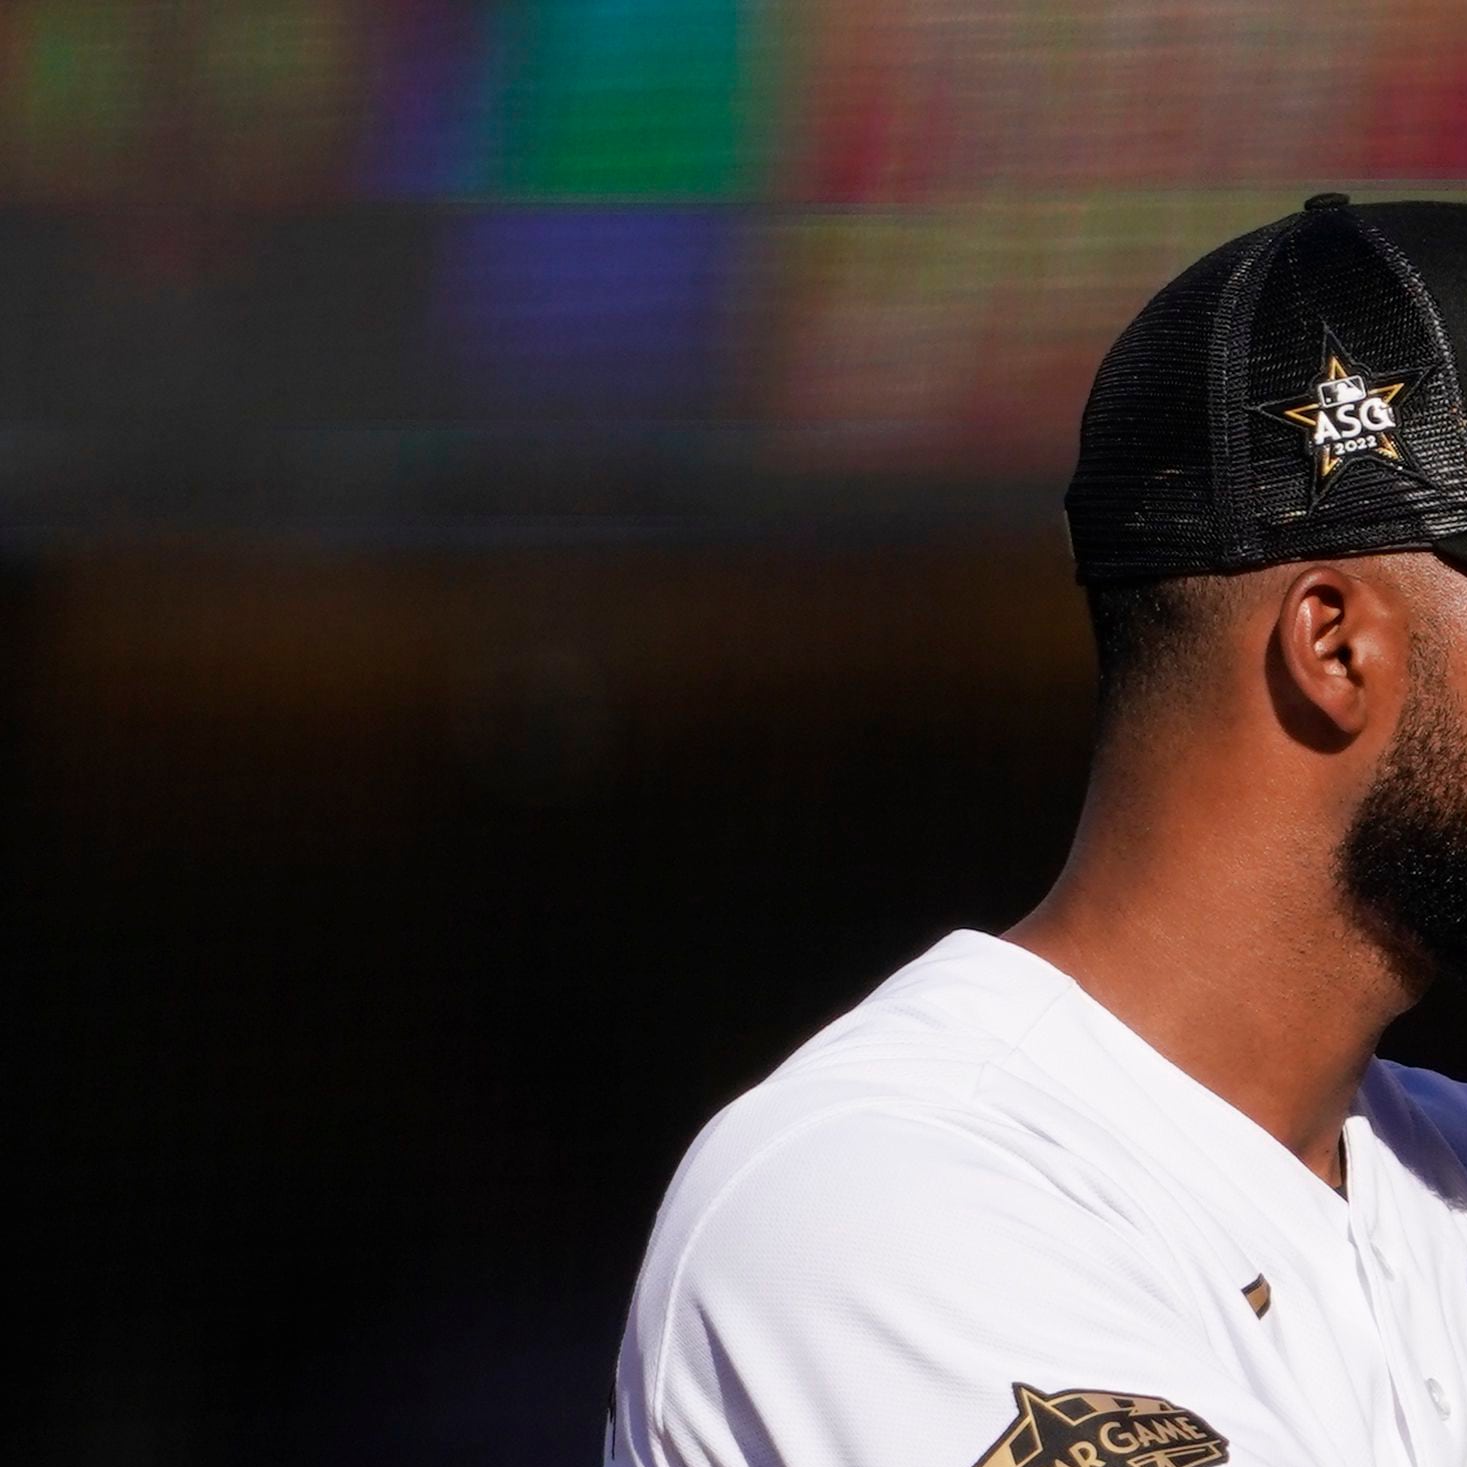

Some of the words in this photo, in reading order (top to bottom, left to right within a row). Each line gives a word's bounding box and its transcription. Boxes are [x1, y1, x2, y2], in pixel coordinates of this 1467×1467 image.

[1314, 397, 1396, 445] ASG
[1334, 435, 1378, 455] 2022
[1099, 1416, 1207, 1455] GAME
